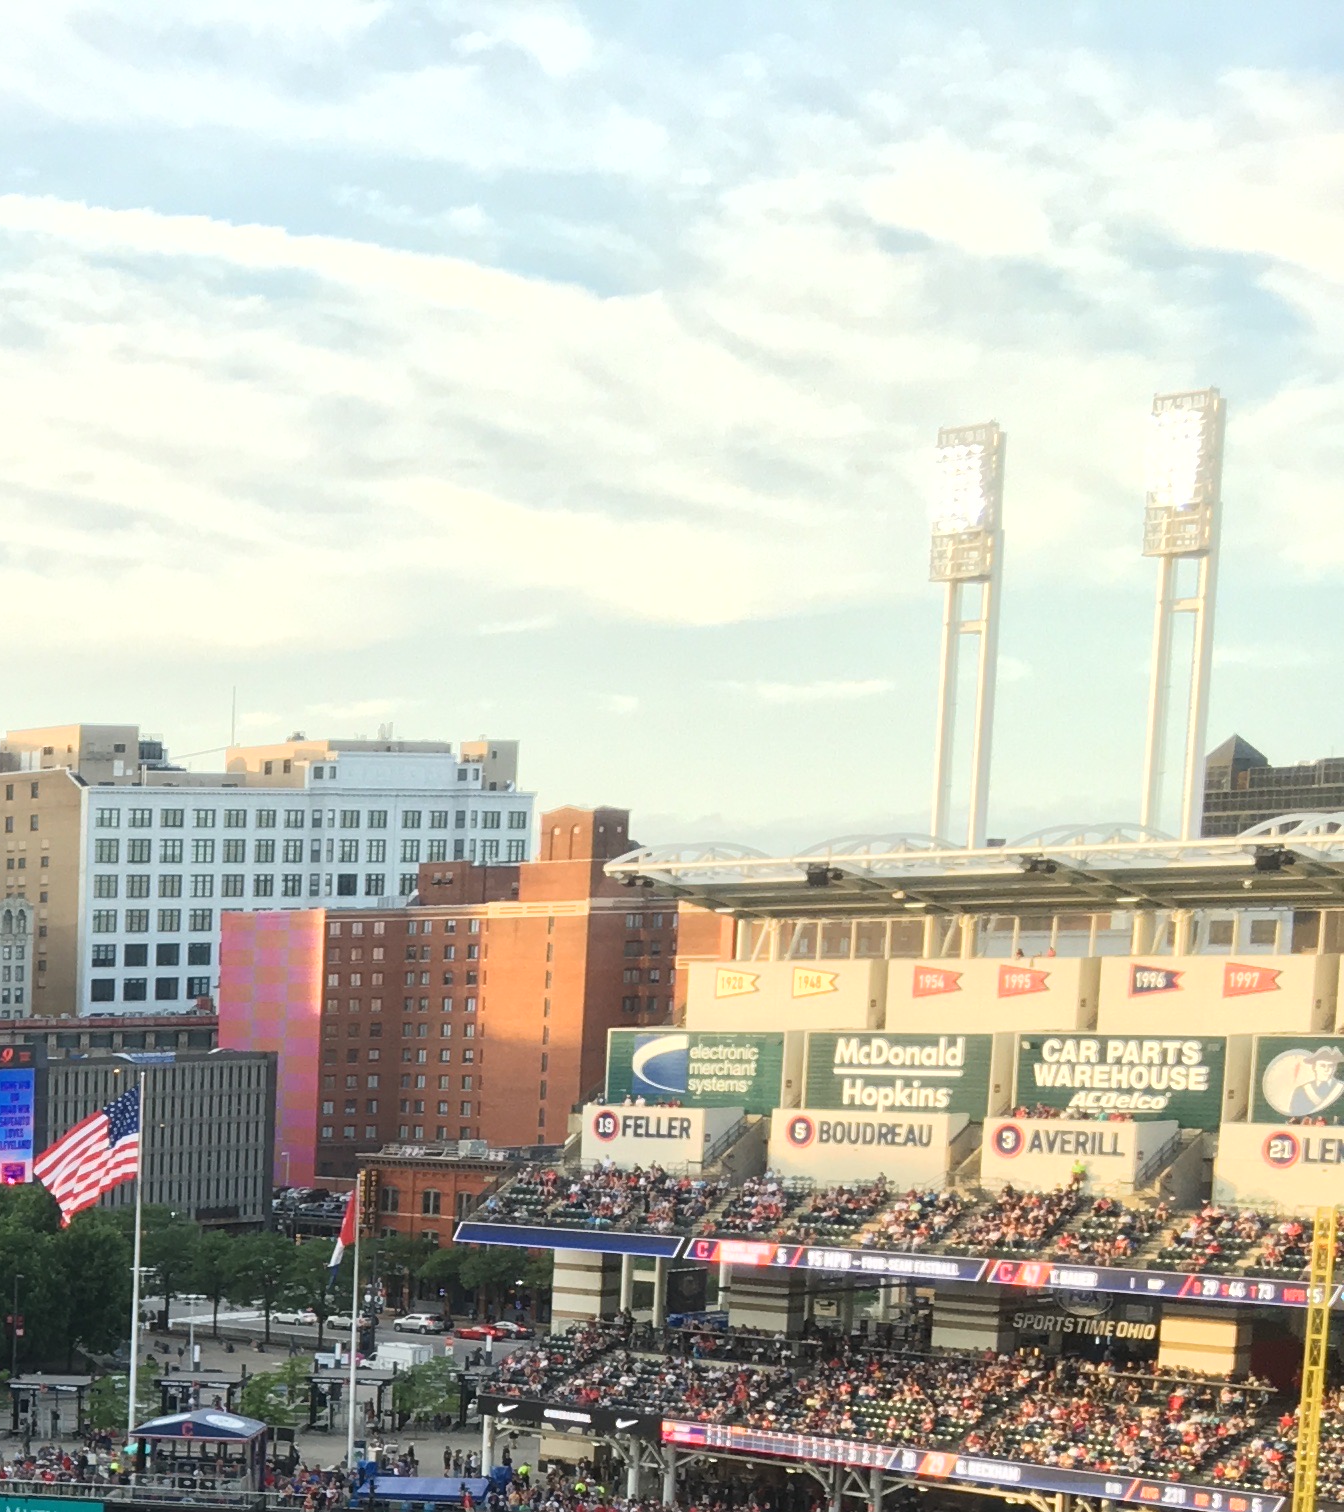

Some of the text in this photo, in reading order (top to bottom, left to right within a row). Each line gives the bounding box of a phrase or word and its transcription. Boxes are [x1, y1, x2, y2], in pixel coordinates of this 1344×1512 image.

[720, 976, 744, 990] 1920
[797, 976, 822, 989] 1948
[918, 974, 945, 989] 1954
[1004, 974, 1031, 989] 1995
[1135, 971, 1166, 988] 1996
[1229, 972, 1259, 987] 1997
[690, 1043, 759, 1061] electronic
[833, 1036, 966, 1068] McDonald
[1042, 1038, 1203, 1066] CAR PARTS
[689, 1060, 757, 1076] merchant
[688, 1077, 748, 1095] systems
[1033, 1063, 1210, 1092] WAREHOUSE
[842, 1078, 950, 1114] Hopkins
[1068, 1092, 1167, 1110] ACDelco
[598, 1115, 691, 1139] 19 FELLER
[795, 1121, 934, 1147] 5 BOUDREAU
[1002, 1129, 1125, 1157] 3 AVERILL
[1270, 1137, 1344, 1164] 21 LE
[1116, 1321, 1156, 1340] OHIO
